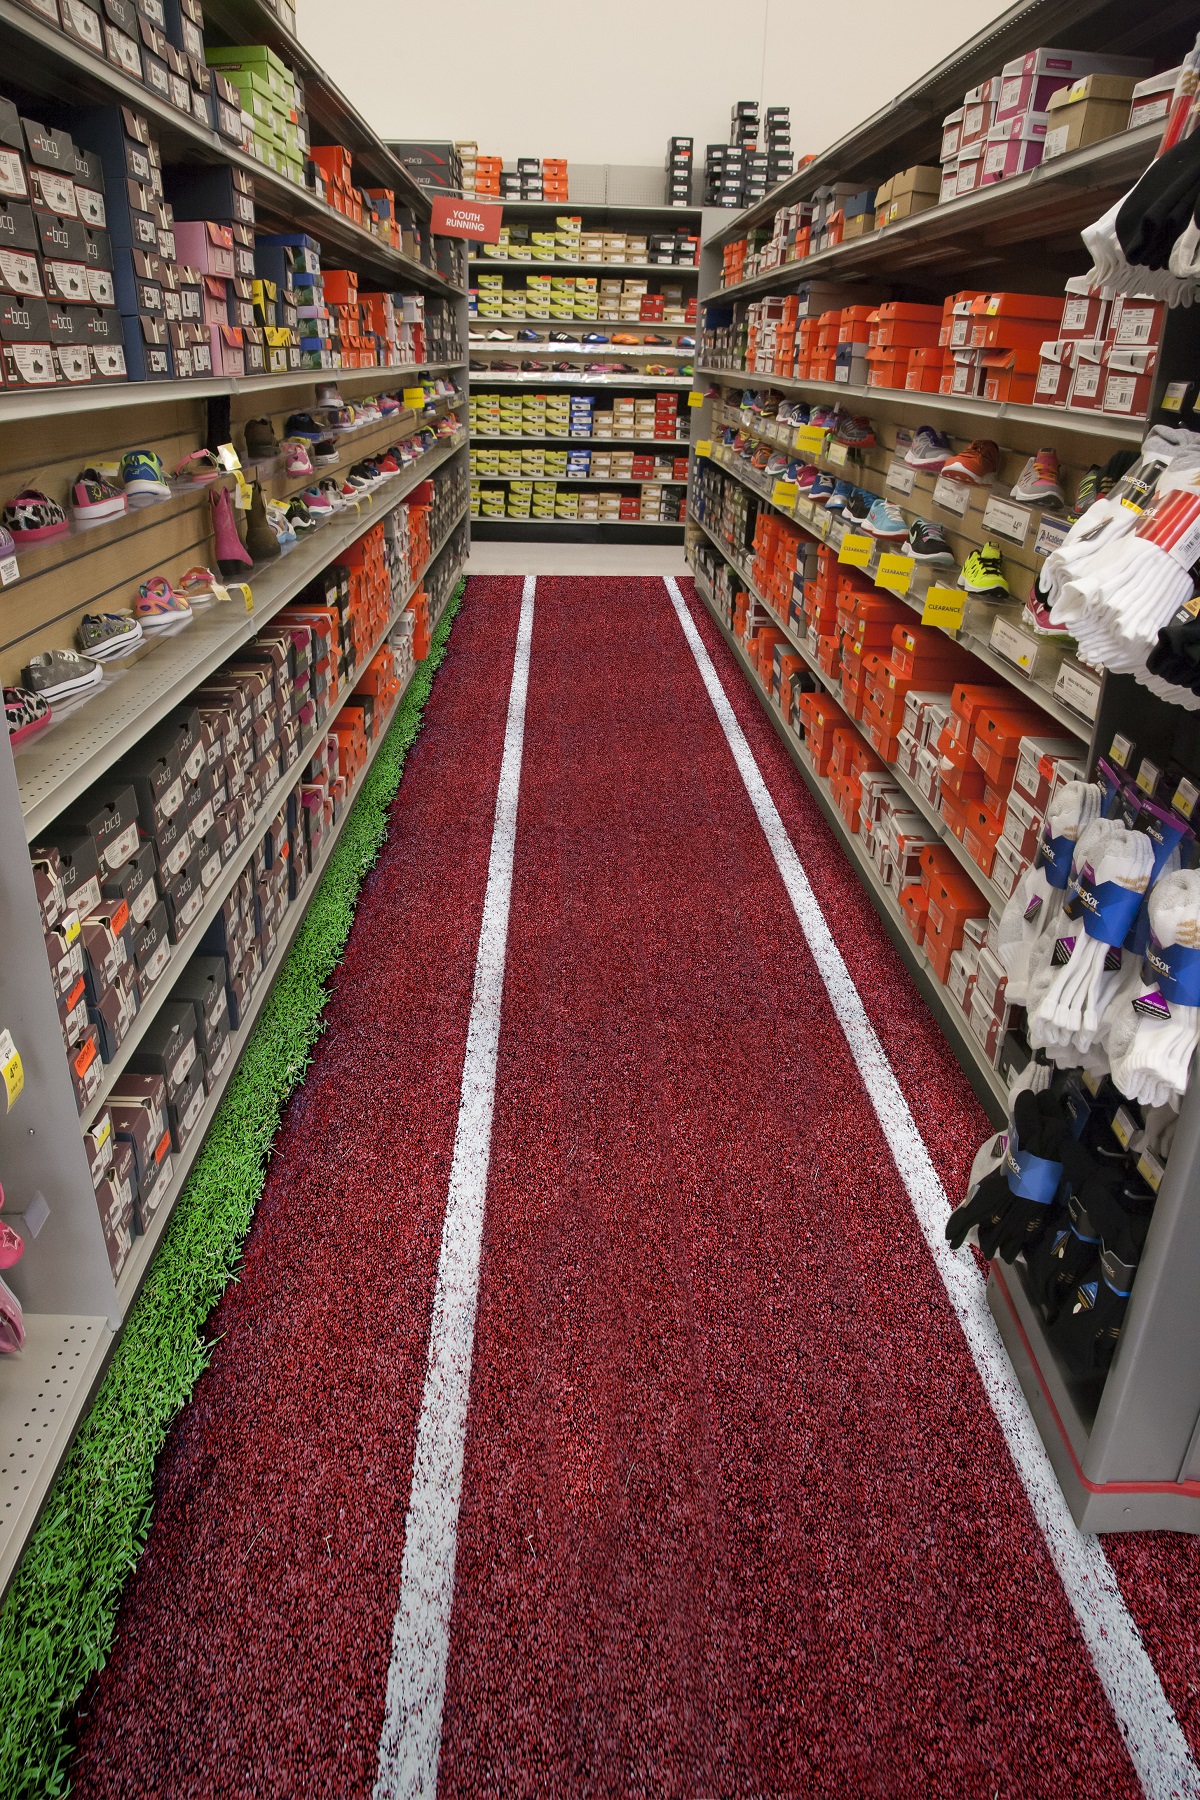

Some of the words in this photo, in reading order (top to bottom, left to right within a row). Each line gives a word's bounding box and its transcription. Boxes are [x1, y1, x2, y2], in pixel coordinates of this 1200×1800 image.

[453, 210, 480, 222] YOUTH
[446, 218, 485, 232] RUNNING
[843, 546, 868, 554] CLEARANCE
[881, 568, 909, 577] CLEARANCE
[928, 604, 961, 613] CLEARANCE
[113, 904, 127, 928] DISPLAY
[77, 1043, 93, 1068] DISPLAY
